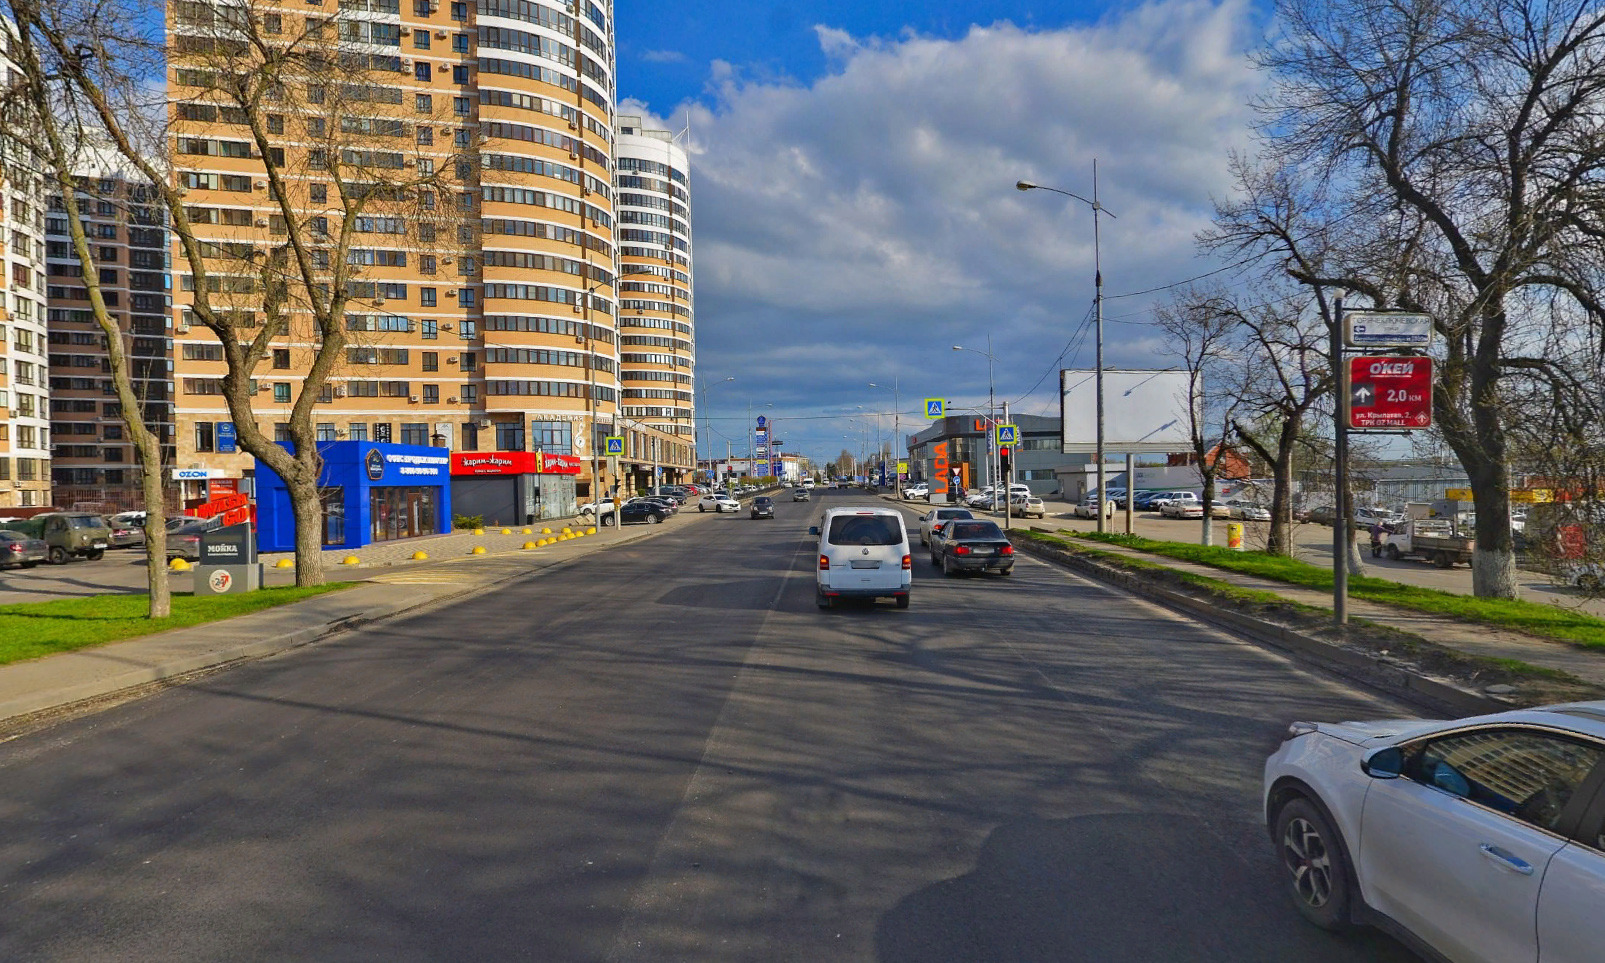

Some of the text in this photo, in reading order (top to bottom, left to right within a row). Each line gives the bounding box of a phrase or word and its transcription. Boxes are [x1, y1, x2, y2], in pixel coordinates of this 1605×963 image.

[1387, 389, 1407, 402] 2,0
[536, 414, 584, 422] АКАДЕМИЯ
[934, 441, 949, 493] LADA
[207, 544, 238, 552] МОЙКА
